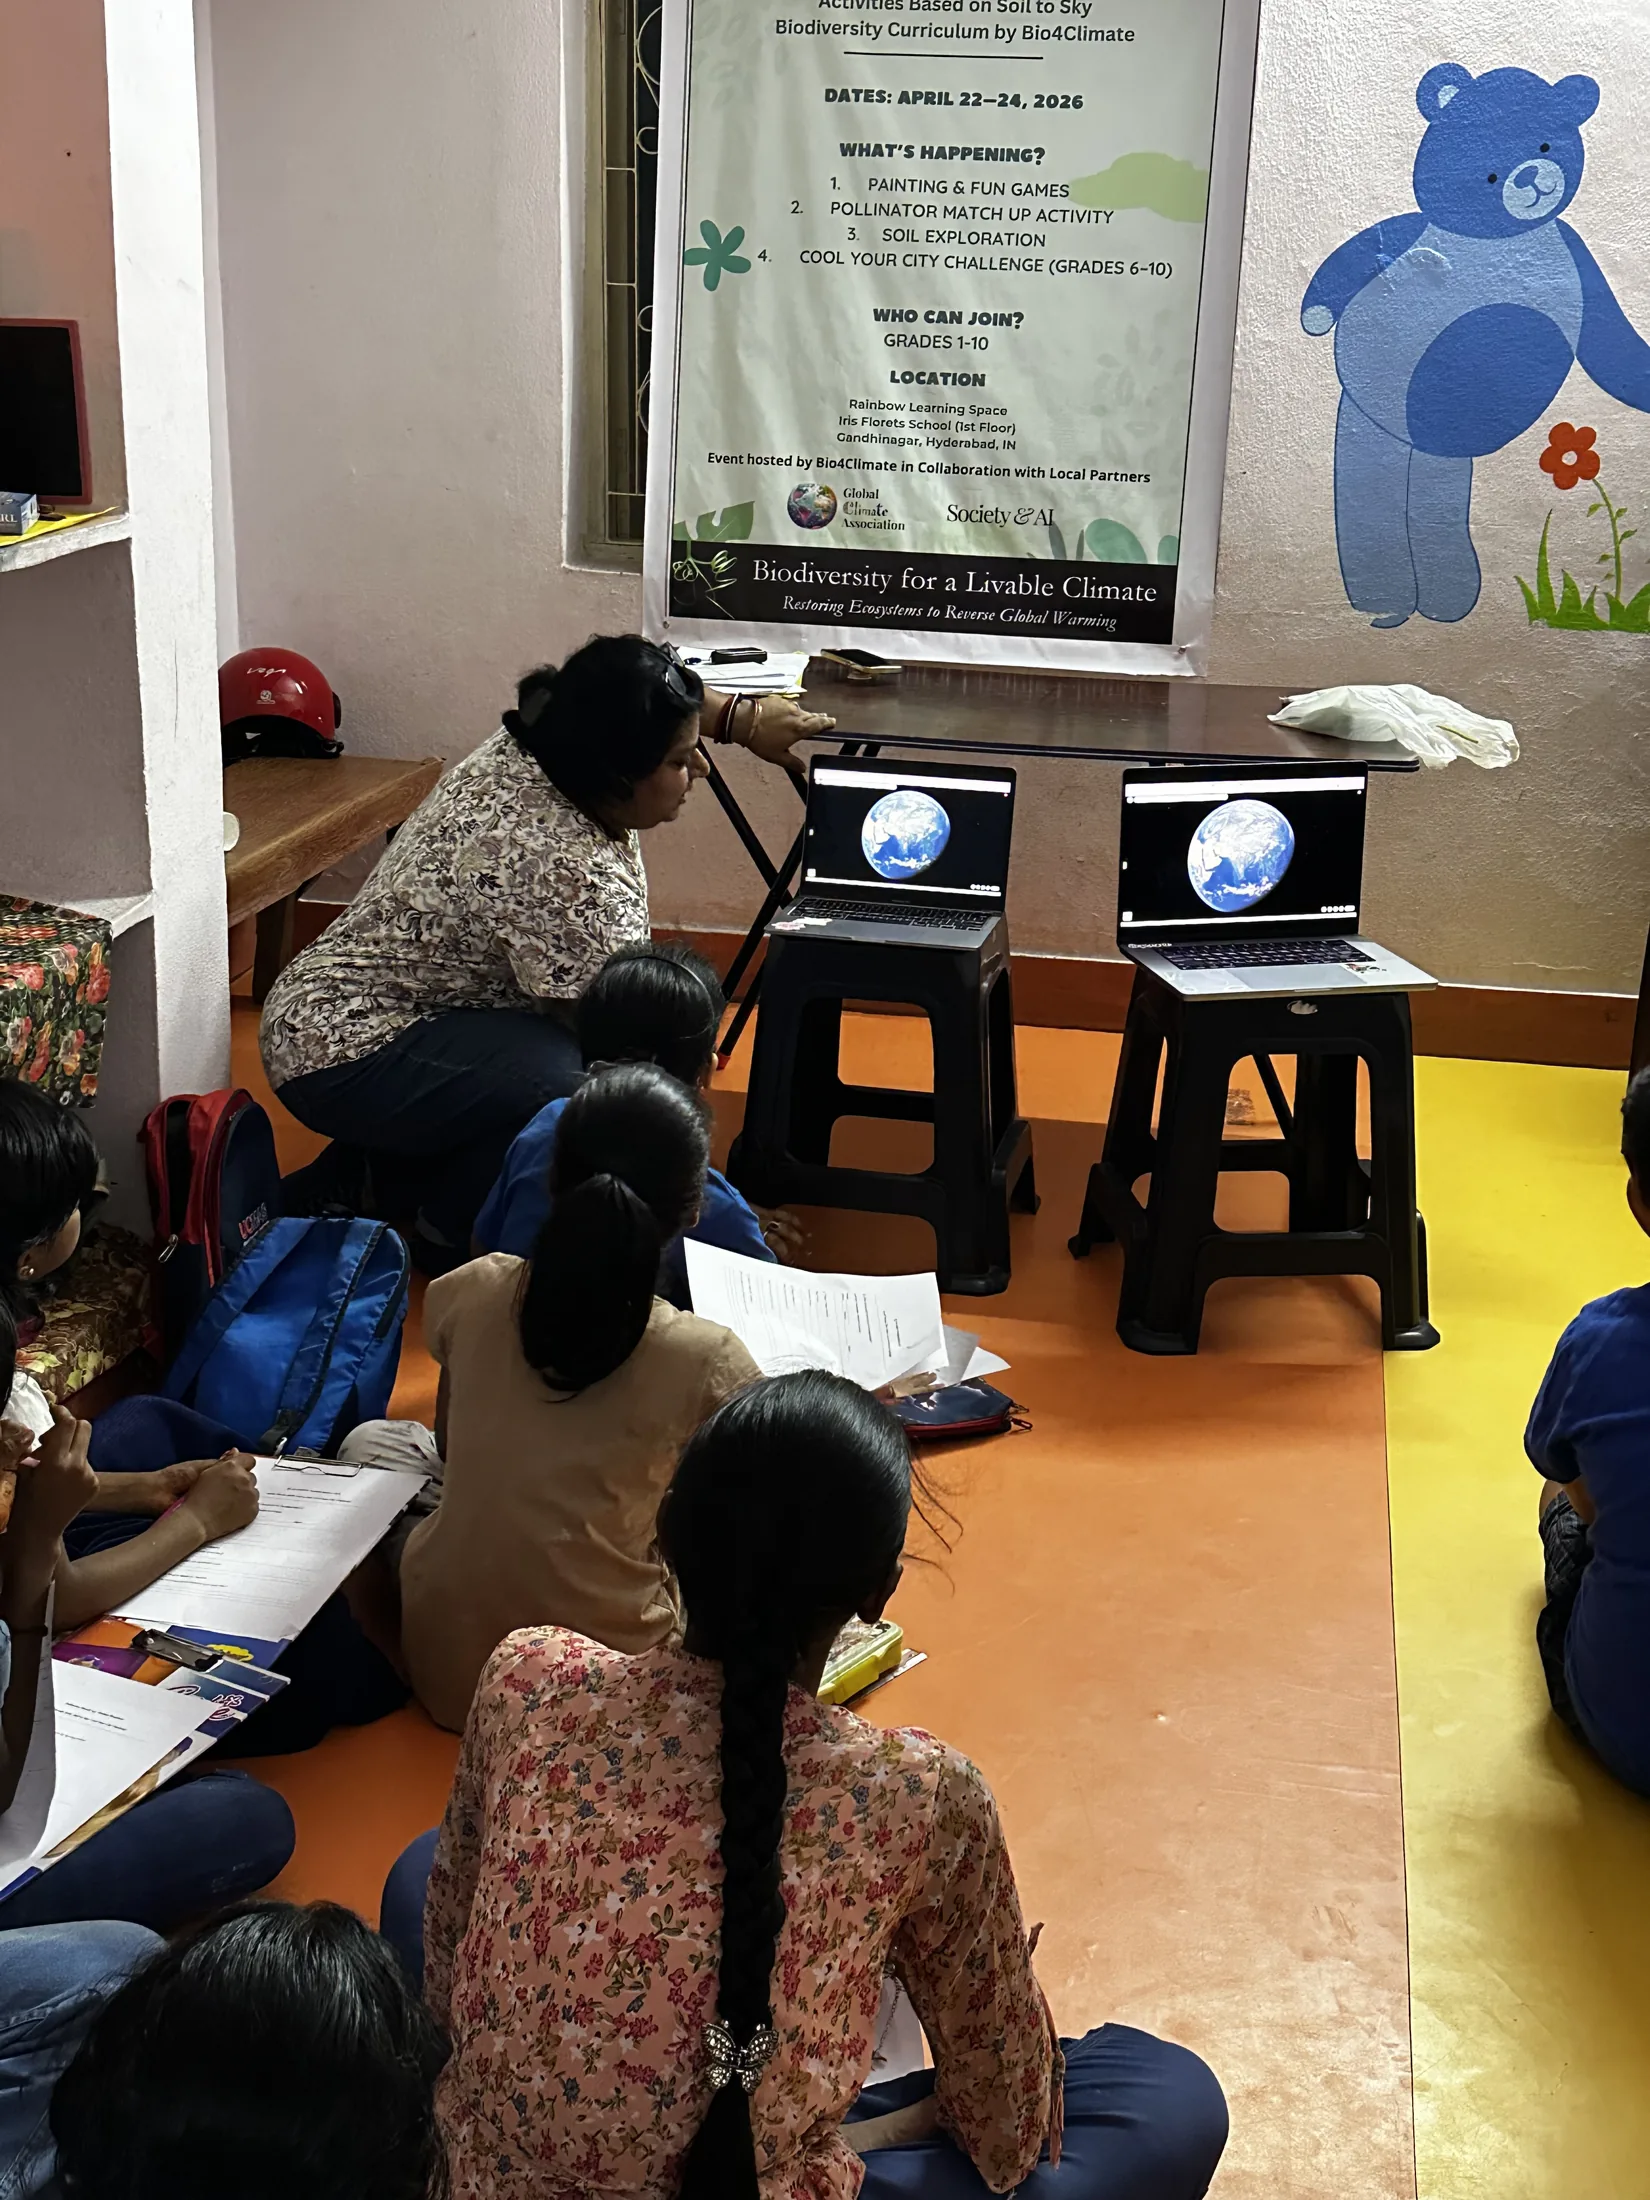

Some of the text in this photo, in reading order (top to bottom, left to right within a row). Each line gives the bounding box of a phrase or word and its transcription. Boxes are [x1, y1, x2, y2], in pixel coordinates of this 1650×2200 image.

[819, 0, 1092, 18] Activities Based on Soil to Sky
[776, 19, 1134, 43] Biodiversity Curriculum by Bio4Climate
[825, 89, 892, 103] DATES:
[898, 91, 954, 105] APRIL
[1034, 94, 1083, 109] 2026
[840, 143, 1045, 165] WHAT’S HAPPENING?
[831, 177, 1069, 197] 1. PAINTING & FUN GAMES
[791, 200, 1114, 223] 2. POLLINATOR MATCH UP ACTIVITY
[847, 227, 1045, 247] 3. SOIL EXPLORATION
[757, 249, 772, 262] 4.
[800, 250, 844, 264] COOL
[851, 252, 896, 266] YOUR
[903, 254, 939, 267] CITY
[945, 256, 1044, 272] CHALLENGE
[1049, 260, 1124, 275] (GRADES
[873, 309, 1024, 329] WHO CAN JOIN?
[884, 334, 988, 350] GRADES 1-10
[890, 371, 986, 386] LOCATION
[850, 399, 1007, 416] Rainbow Learning Space
[839, 415, 1015, 435] Iris Florets School (1st Floor)
[837, 433, 1016, 450] Gandhinagar, Hyderabad, IN
[708, 453, 1150, 482] Event hosted by Bio4Climate in Collaboration with Local Partners
[844, 488, 878, 499] Global
[843, 502, 888, 516] Climate
[947, 505, 1055, 528] Society & AI
[841, 518, 905, 531] Association
[754, 560, 1156, 601] Biodiversity for a Livable Climate
[784, 596, 1116, 631] Restoring Ecosystems to Reverse Global Warming
